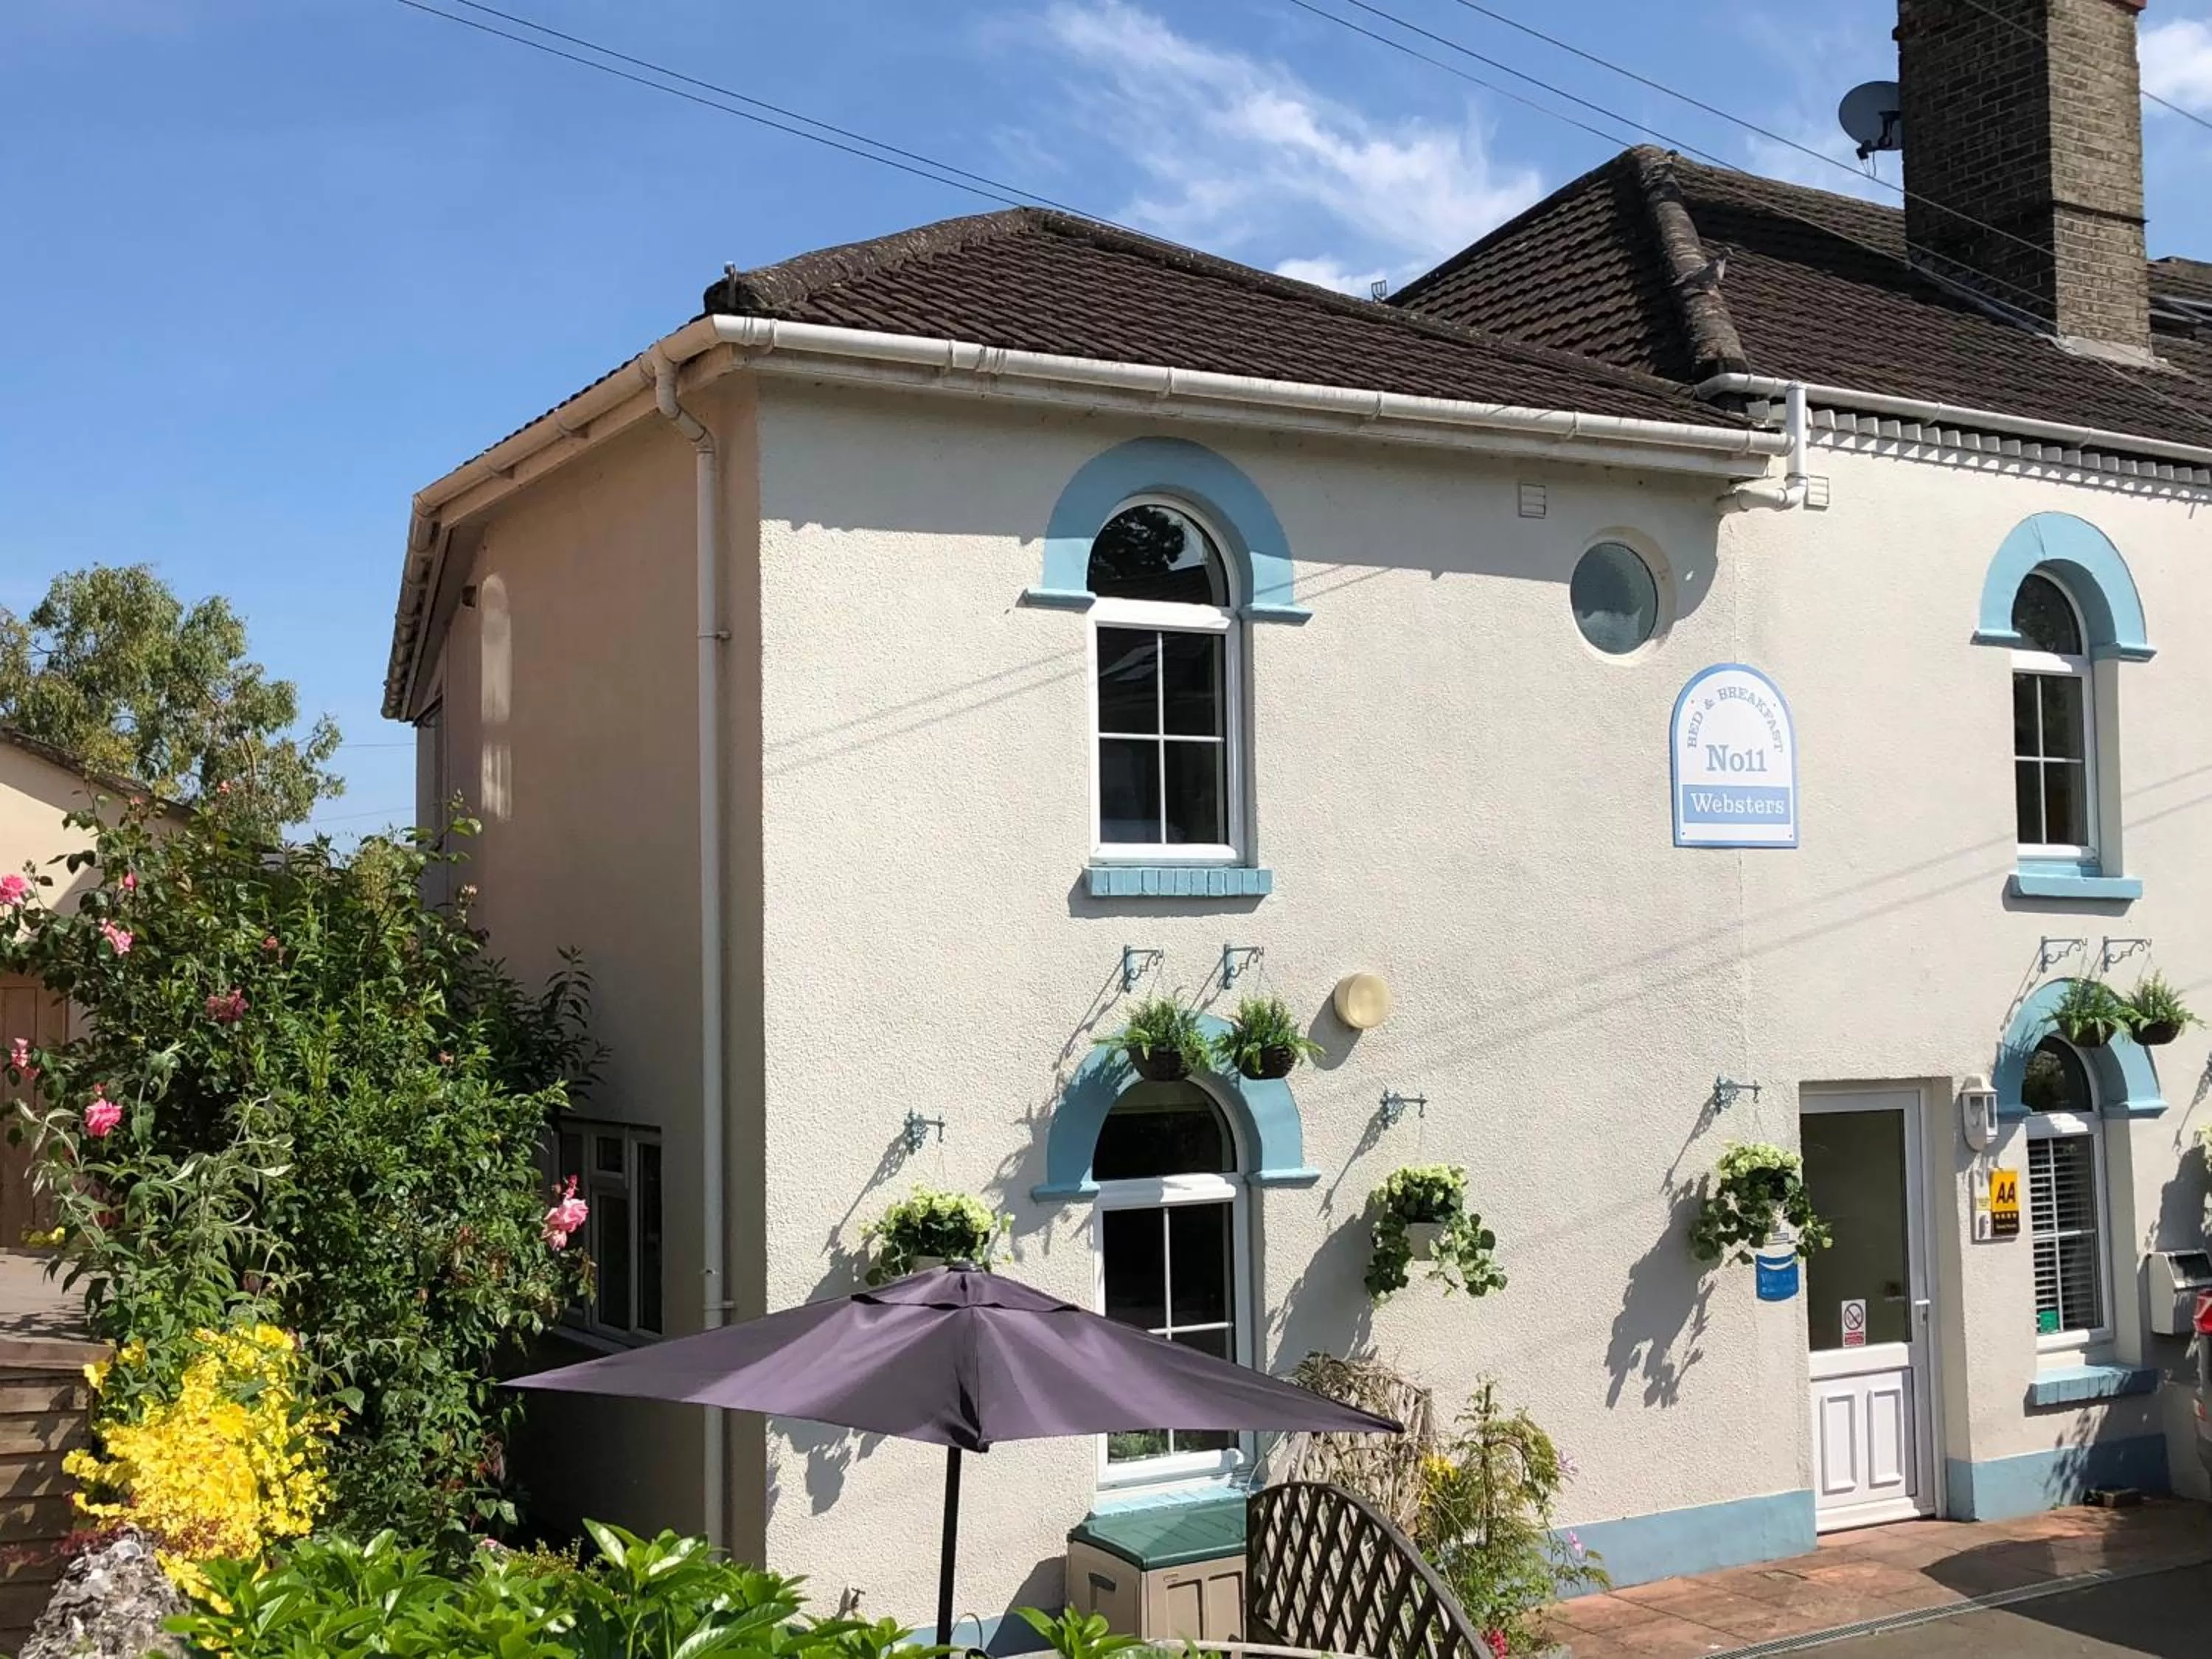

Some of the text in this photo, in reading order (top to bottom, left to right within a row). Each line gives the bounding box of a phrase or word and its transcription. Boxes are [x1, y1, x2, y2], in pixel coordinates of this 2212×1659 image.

[1717, 686, 1783, 753] BREAKFAST
[1705, 744, 1767, 772] No11
[1690, 793, 1785, 815] Websters
[1996, 1181, 2016, 1203] AA
